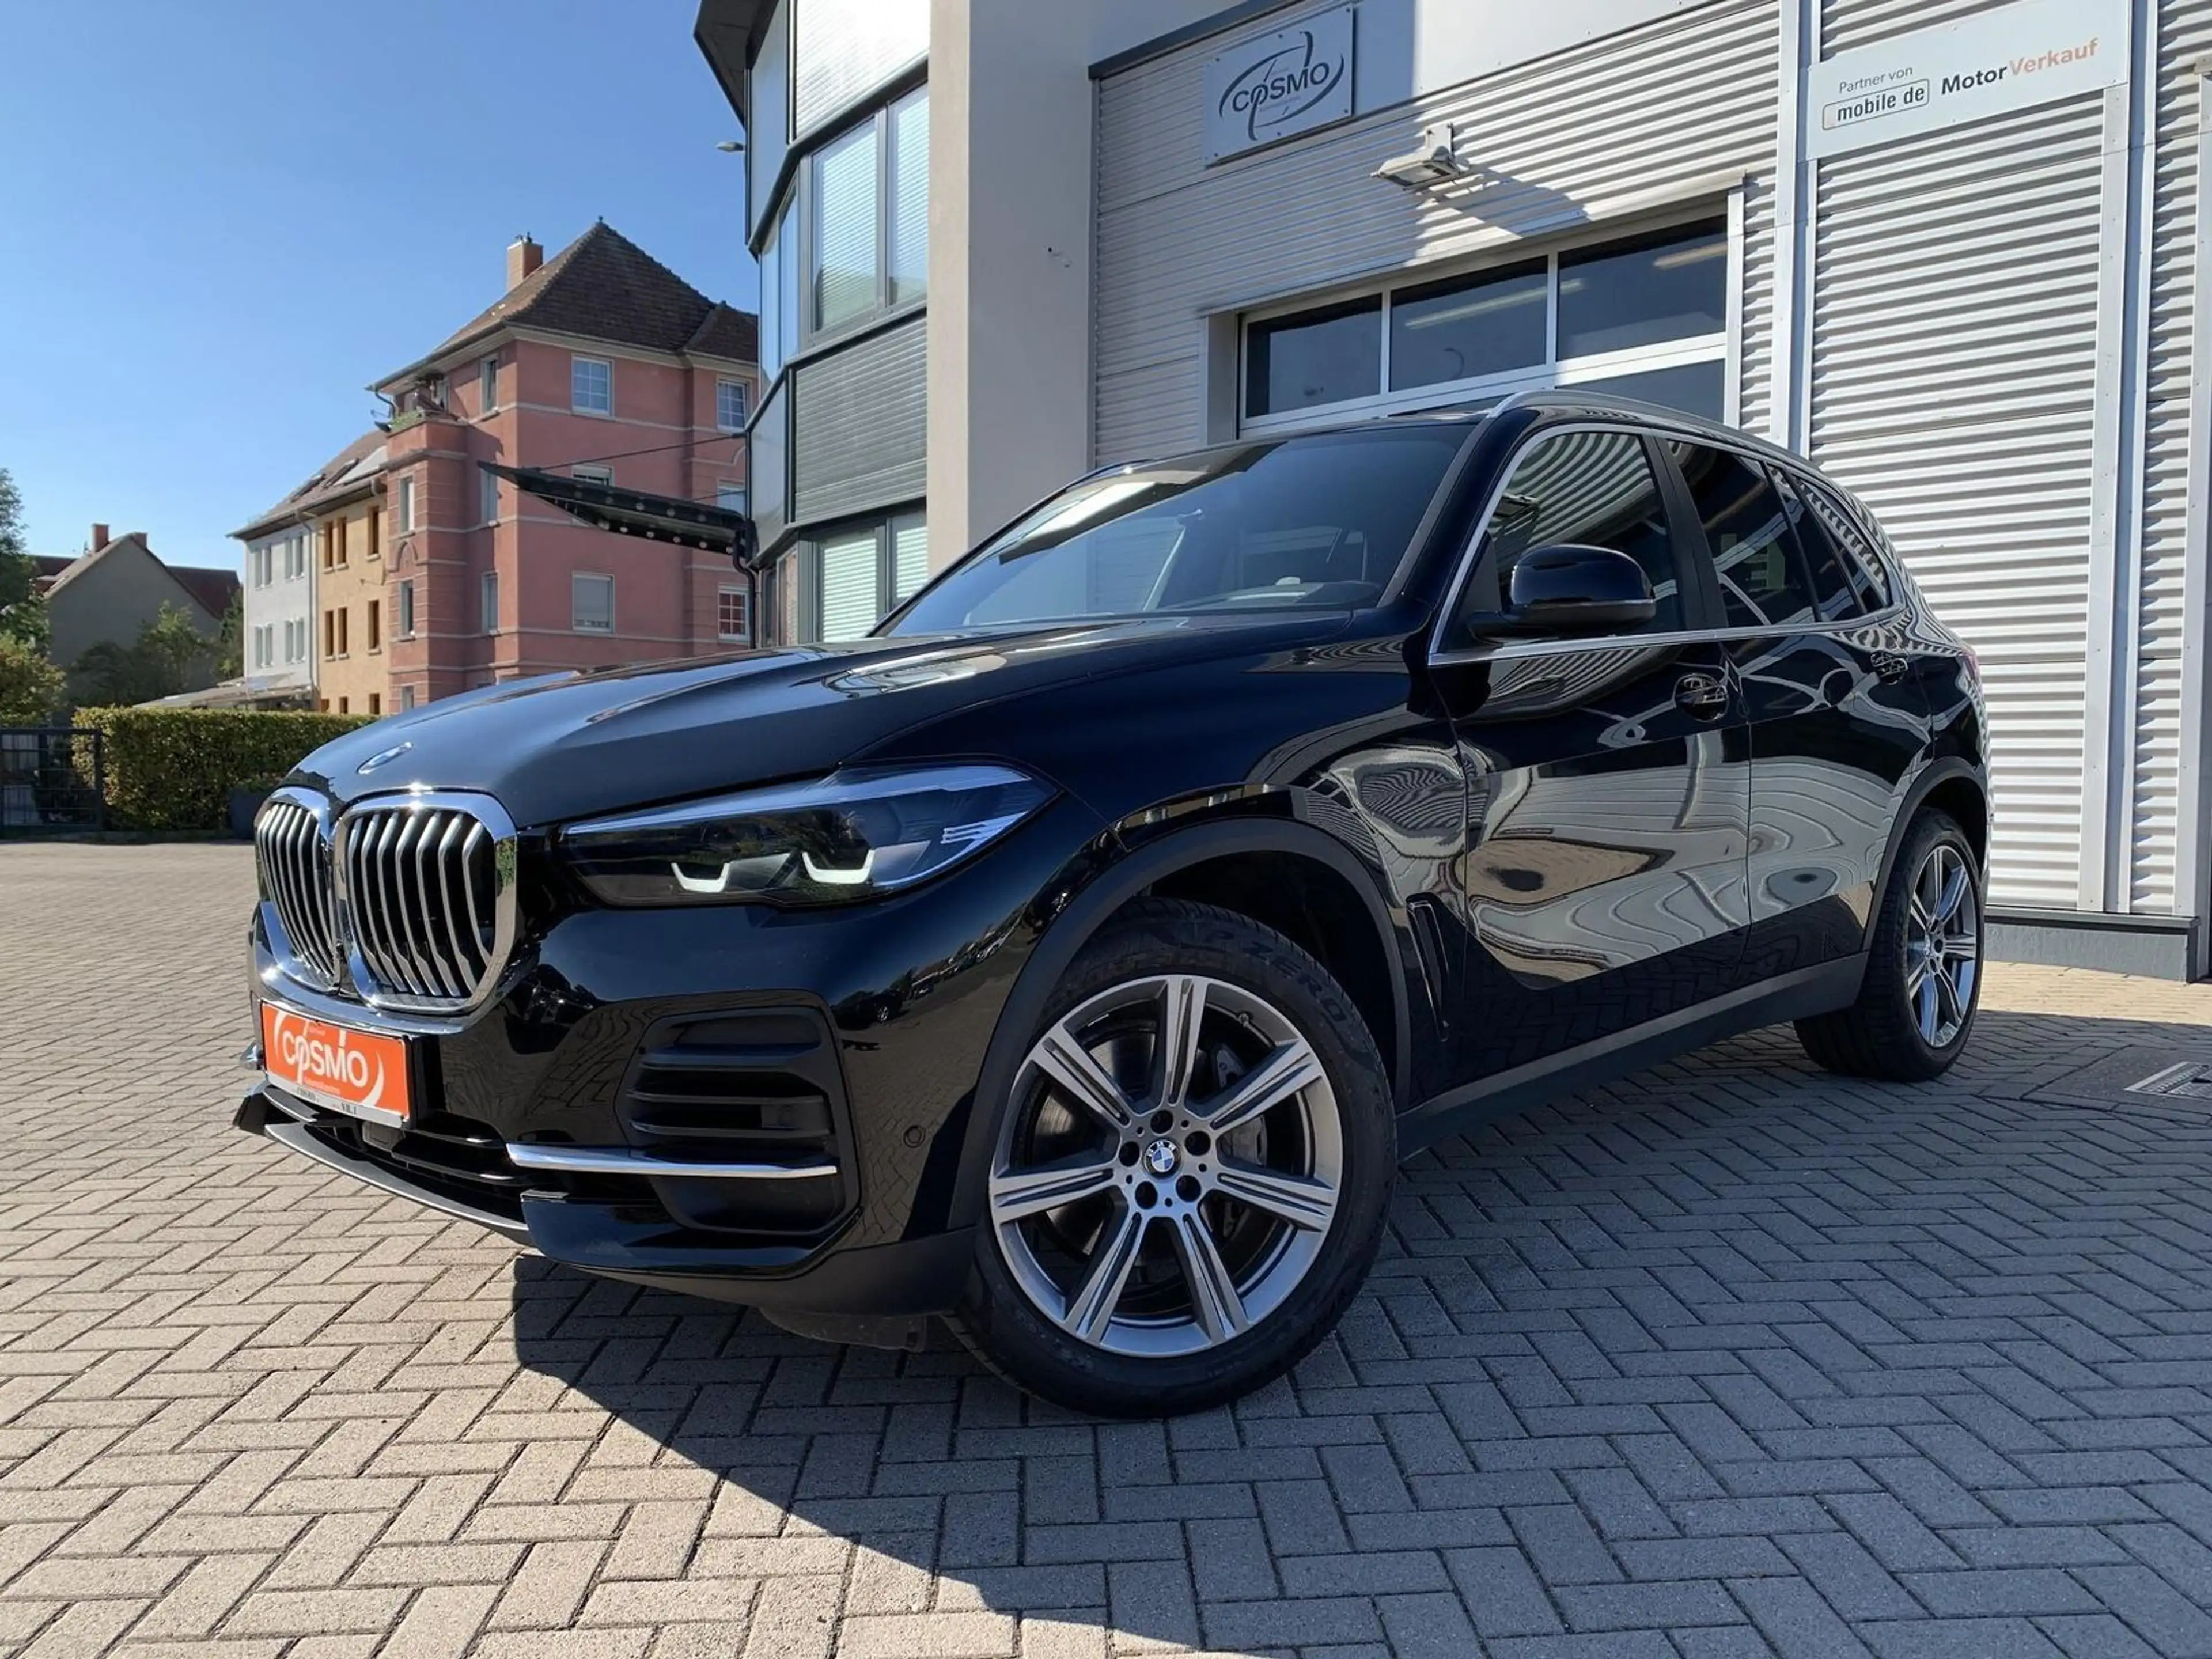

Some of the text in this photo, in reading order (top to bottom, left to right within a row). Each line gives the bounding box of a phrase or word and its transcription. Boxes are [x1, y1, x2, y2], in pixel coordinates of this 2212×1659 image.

[1232, 62, 1330, 112] COSMO
[1839, 67, 1913, 93] Partner von
[282, 1031, 369, 1088] COSMO
